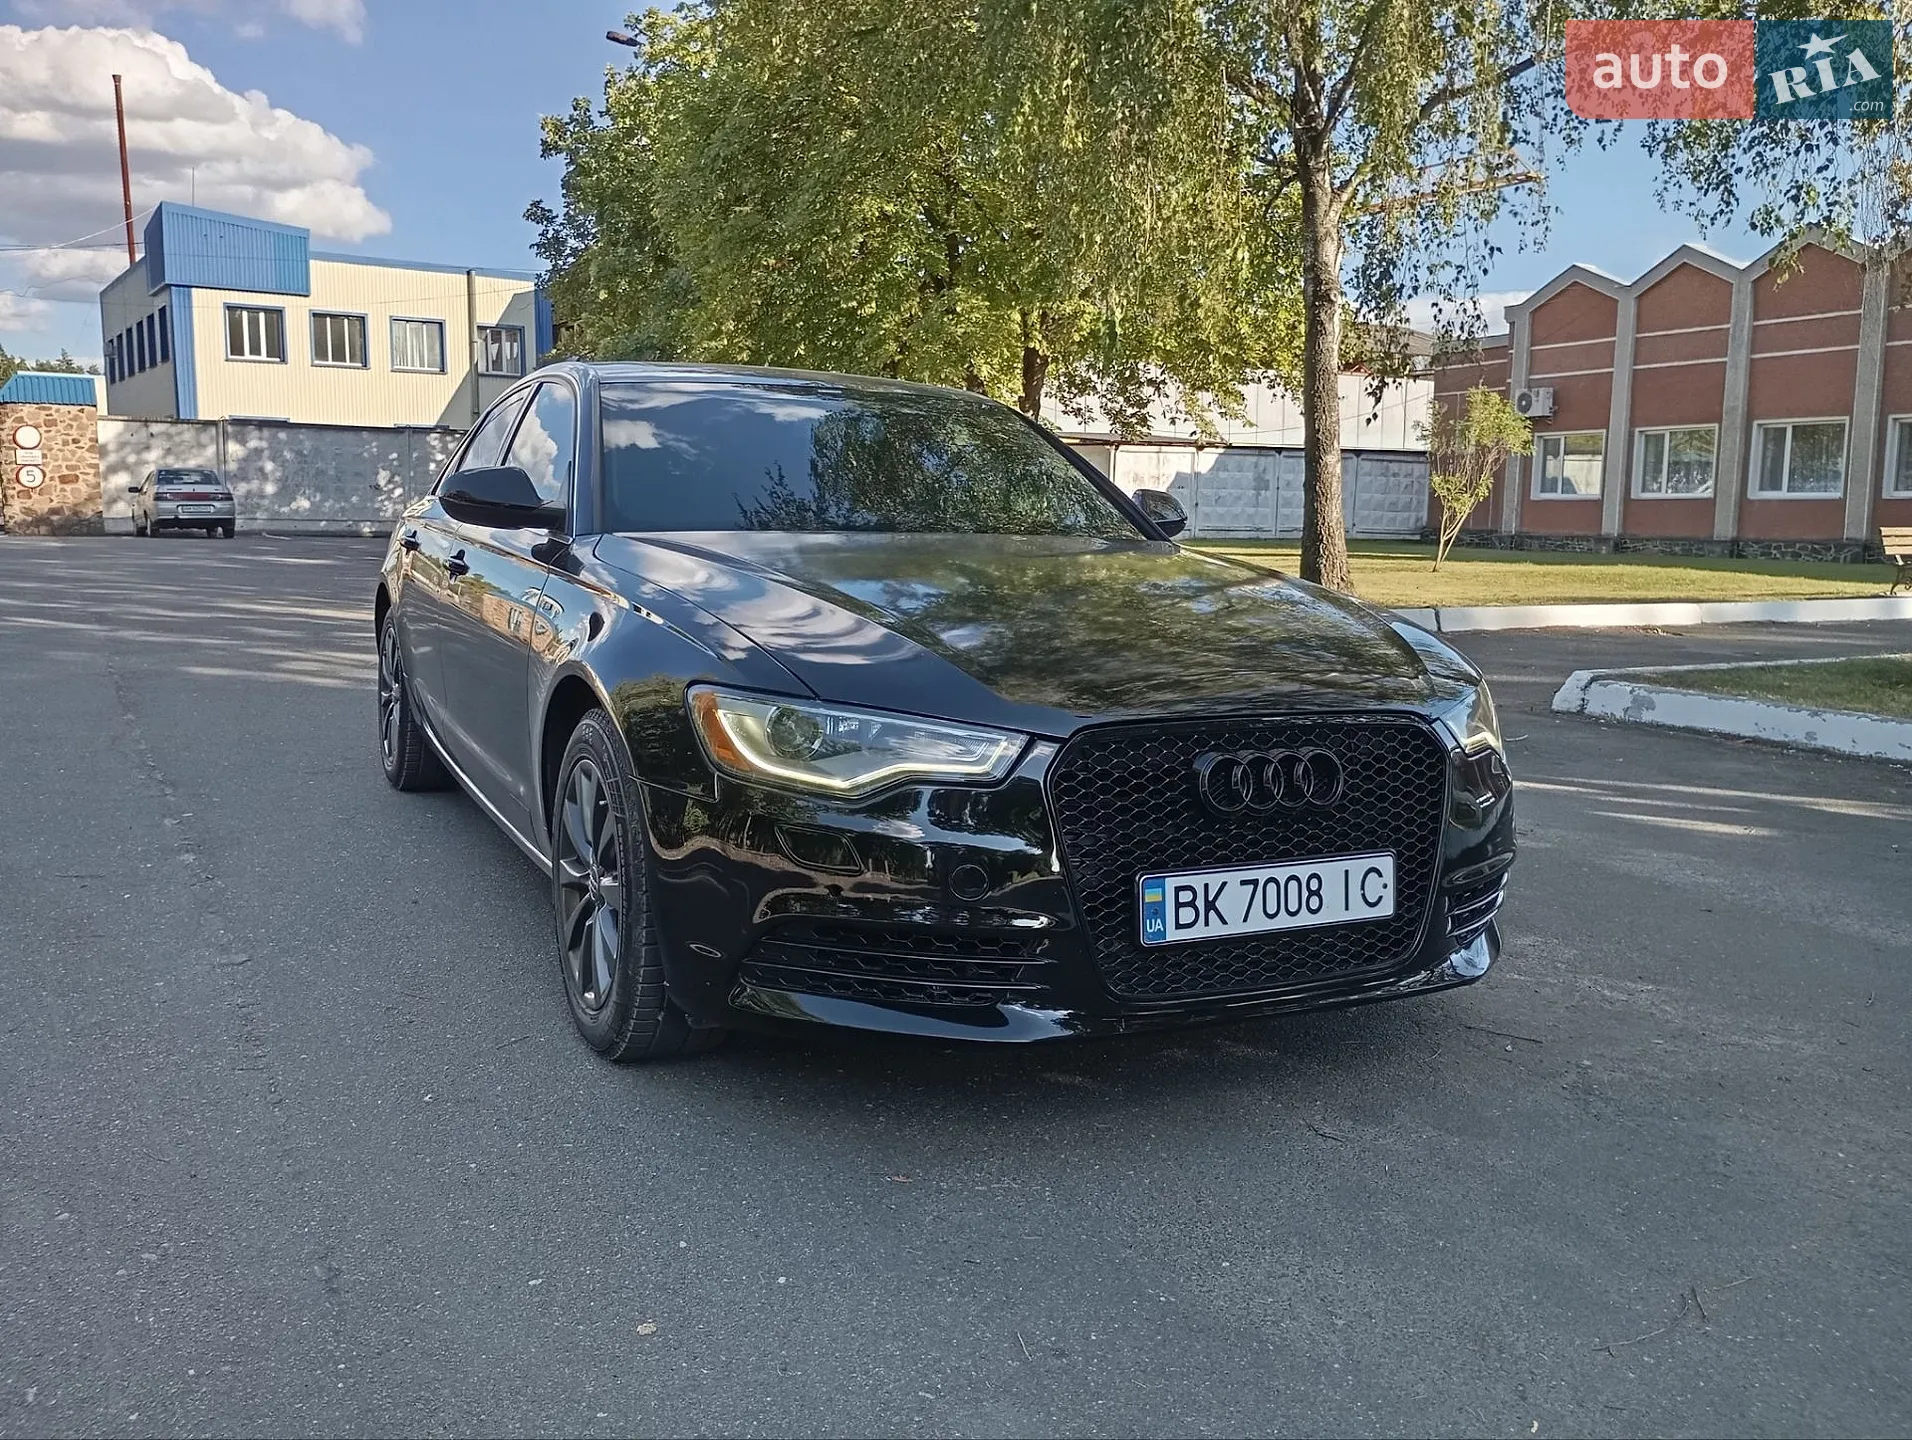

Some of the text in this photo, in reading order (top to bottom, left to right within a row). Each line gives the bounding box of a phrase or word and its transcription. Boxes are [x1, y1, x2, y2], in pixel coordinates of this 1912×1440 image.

[26, 470, 36, 483] 5
[1174, 881, 1228, 930] BK
[1239, 872, 1323, 923] 7008
[1146, 918, 1164, 932] UA
